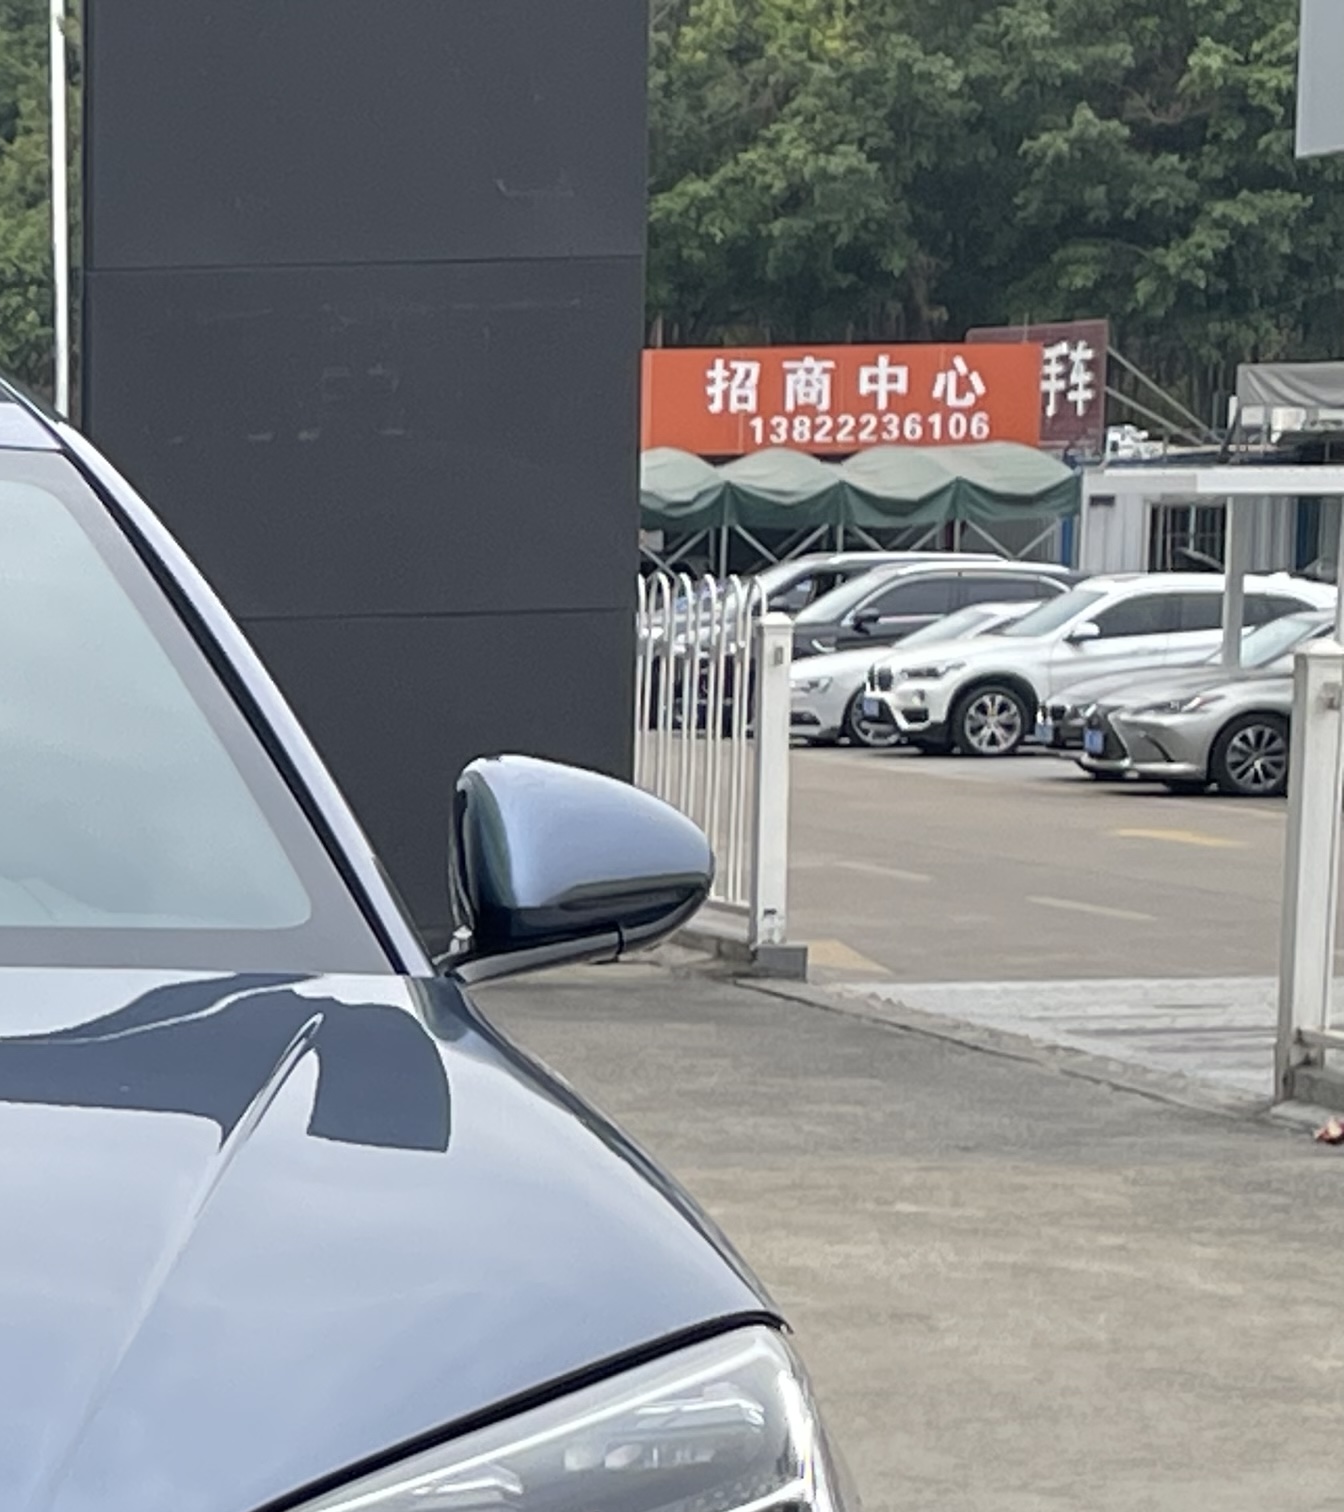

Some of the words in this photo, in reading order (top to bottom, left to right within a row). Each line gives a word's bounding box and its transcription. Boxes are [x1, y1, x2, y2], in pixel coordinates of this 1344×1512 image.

[705, 354, 987, 414] 招商中心
[749, 412, 991, 445] 13822236106
